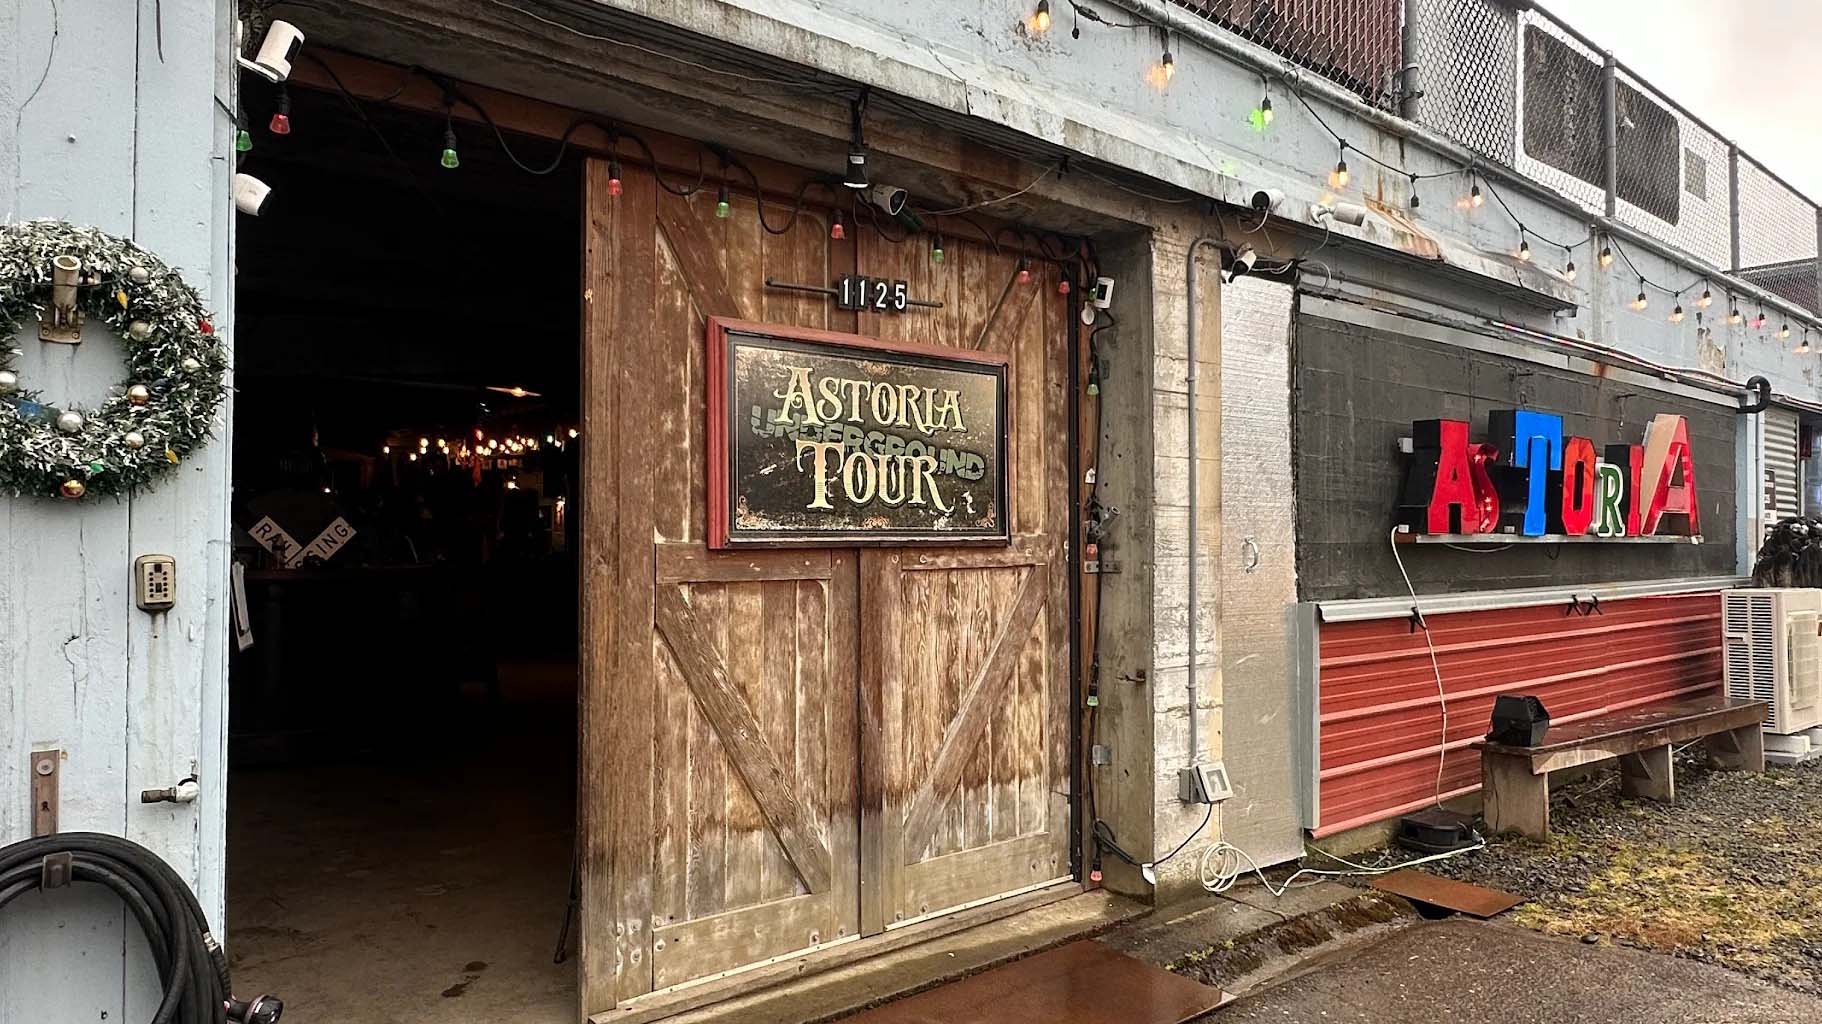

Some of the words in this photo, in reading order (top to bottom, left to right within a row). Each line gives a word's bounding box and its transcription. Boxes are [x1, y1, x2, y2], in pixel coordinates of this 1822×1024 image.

[842, 278, 906, 310] 1125
[773, 367, 968, 434] ASTORIA
[796, 440, 954, 513] TOUR
